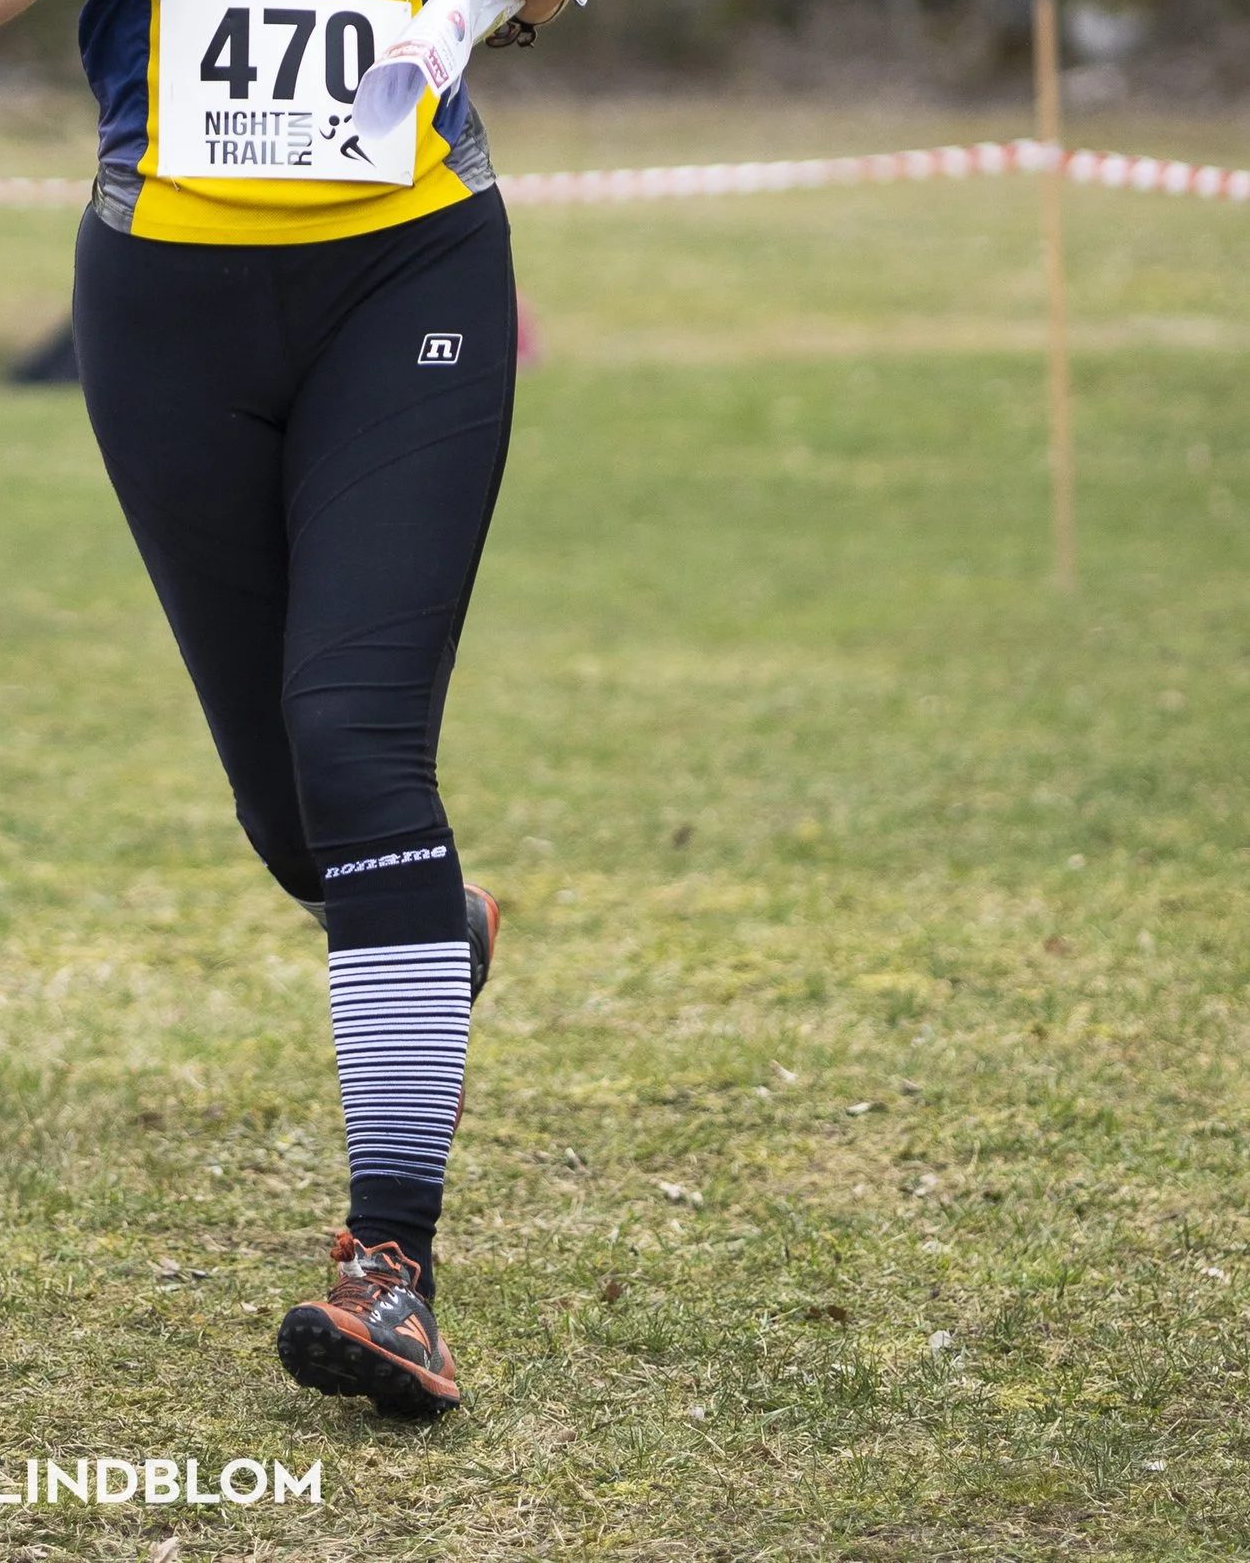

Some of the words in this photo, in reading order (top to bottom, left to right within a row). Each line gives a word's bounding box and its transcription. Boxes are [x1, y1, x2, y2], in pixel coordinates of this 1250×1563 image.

[200, 7, 375, 104] 470
[205, 111, 286, 136] NIGHT
[287, 112, 312, 165] RUN
[205, 140, 285, 165] TRAIL
[325, 845, 448, 878] noname
